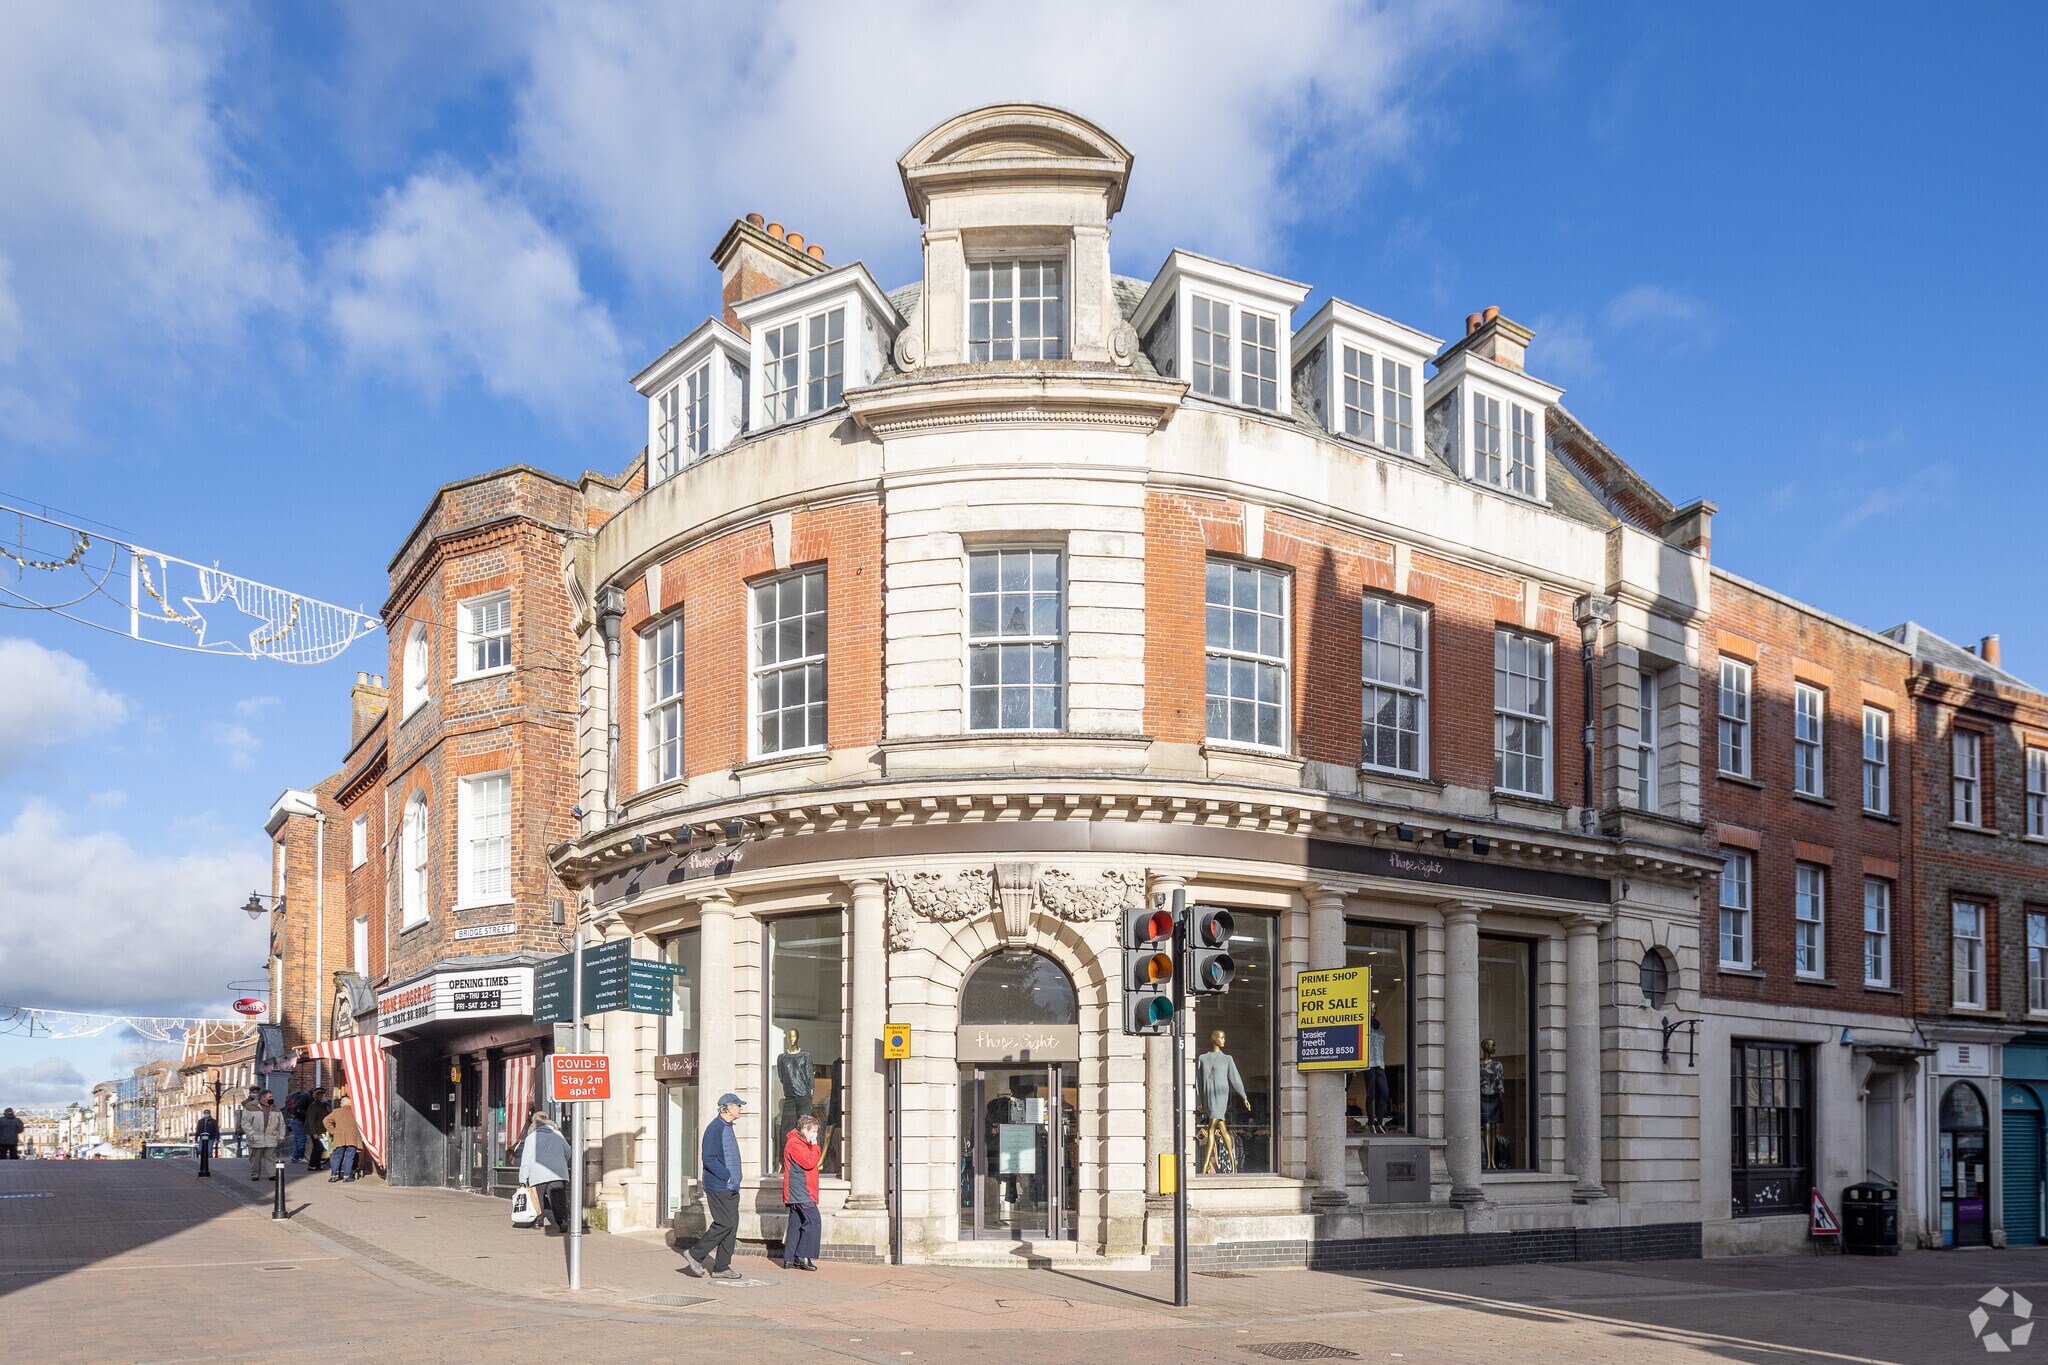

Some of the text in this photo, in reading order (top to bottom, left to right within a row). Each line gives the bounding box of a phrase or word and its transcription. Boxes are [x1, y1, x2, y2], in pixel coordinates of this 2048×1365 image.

[1389, 852, 1417, 870] Phase
[458, 924, 511, 938] BRIDGE STREET
[449, 976, 509, 989] OPENING TIMES
[1301, 971, 1358, 984] PRIME SHOP
[1301, 987, 1327, 997] LEASE
[1301, 998, 1358, 1012] FOR SALE
[1300, 1013, 1364, 1025] ALL ENQUIRIES
[1302, 1030, 1326, 1039] brasier
[976, 1030, 1060, 1055] Phase Eight
[1179, 1039, 1185, 1050] 5
[1302, 1038, 1326, 1047] freeth
[1301, 1046, 1355, 1056] 0203 828 8530
[556, 1059, 606, 1069] COVID-19
[662, 1057, 682, 1072] Phase
[561, 1075, 584, 1086] Stay
[569, 1086, 597, 1097] apart
